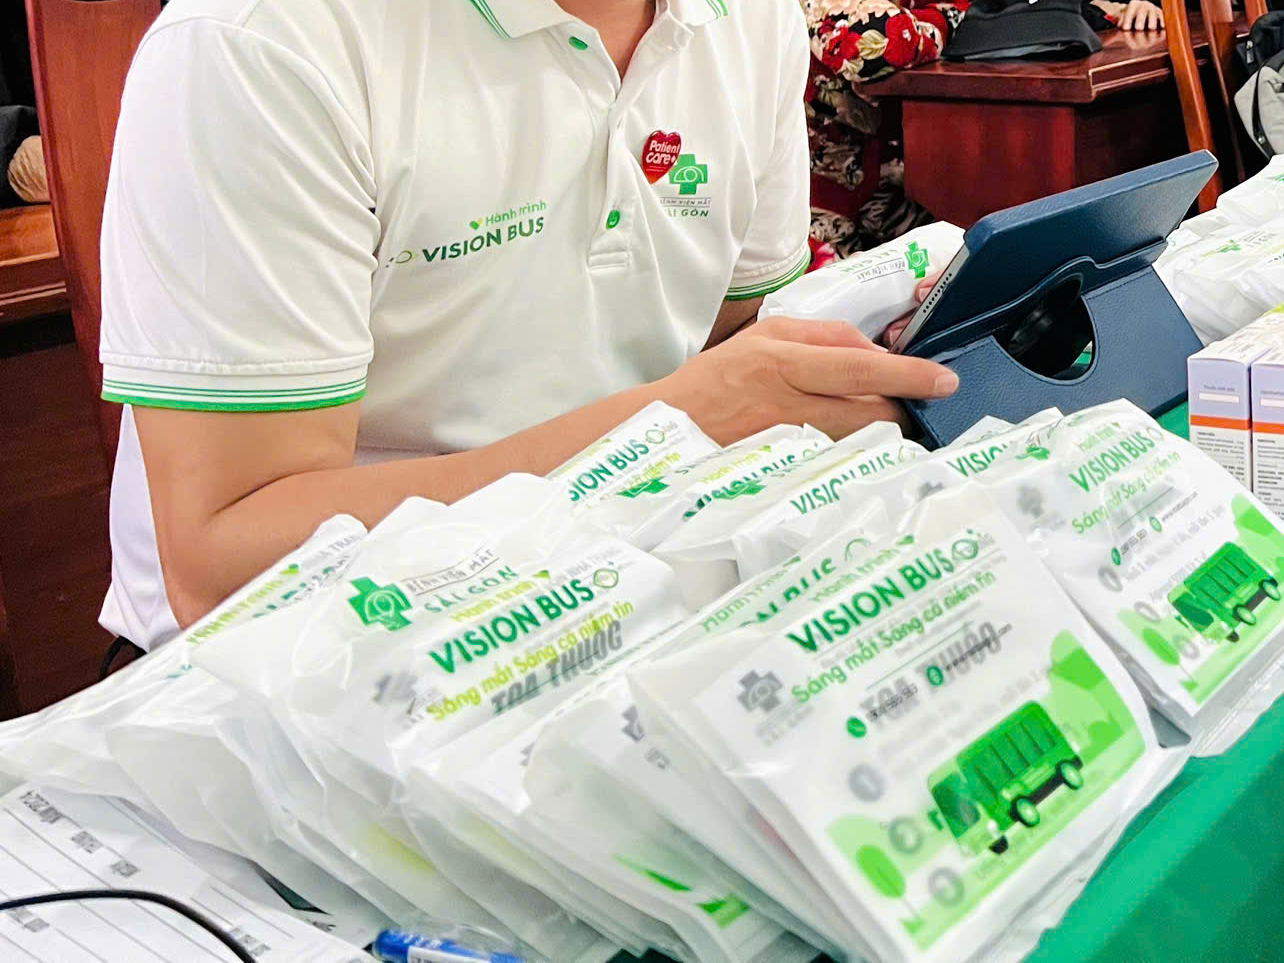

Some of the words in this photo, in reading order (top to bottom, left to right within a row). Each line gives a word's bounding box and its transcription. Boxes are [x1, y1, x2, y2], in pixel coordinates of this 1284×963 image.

[649, 140, 681, 154] Patient
[422, 227, 503, 263] VISION
[507, 216, 545, 242] BUS
[485, 208, 517, 227] Hành
[568, 460, 615, 503] SION
[611, 438, 651, 474] BUS
[1068, 442, 1129, 494] VISION
[1123, 431, 1156, 460] BUS
[427, 602, 542, 675] VISION
[534, 578, 595, 621] BUS
[785, 577, 908, 655] VISION
[898, 550, 956, 593] BUS
[790, 662, 848, 705] Sáng
[845, 637, 882, 671] mắt
[878, 613, 926, 656] Sáng
